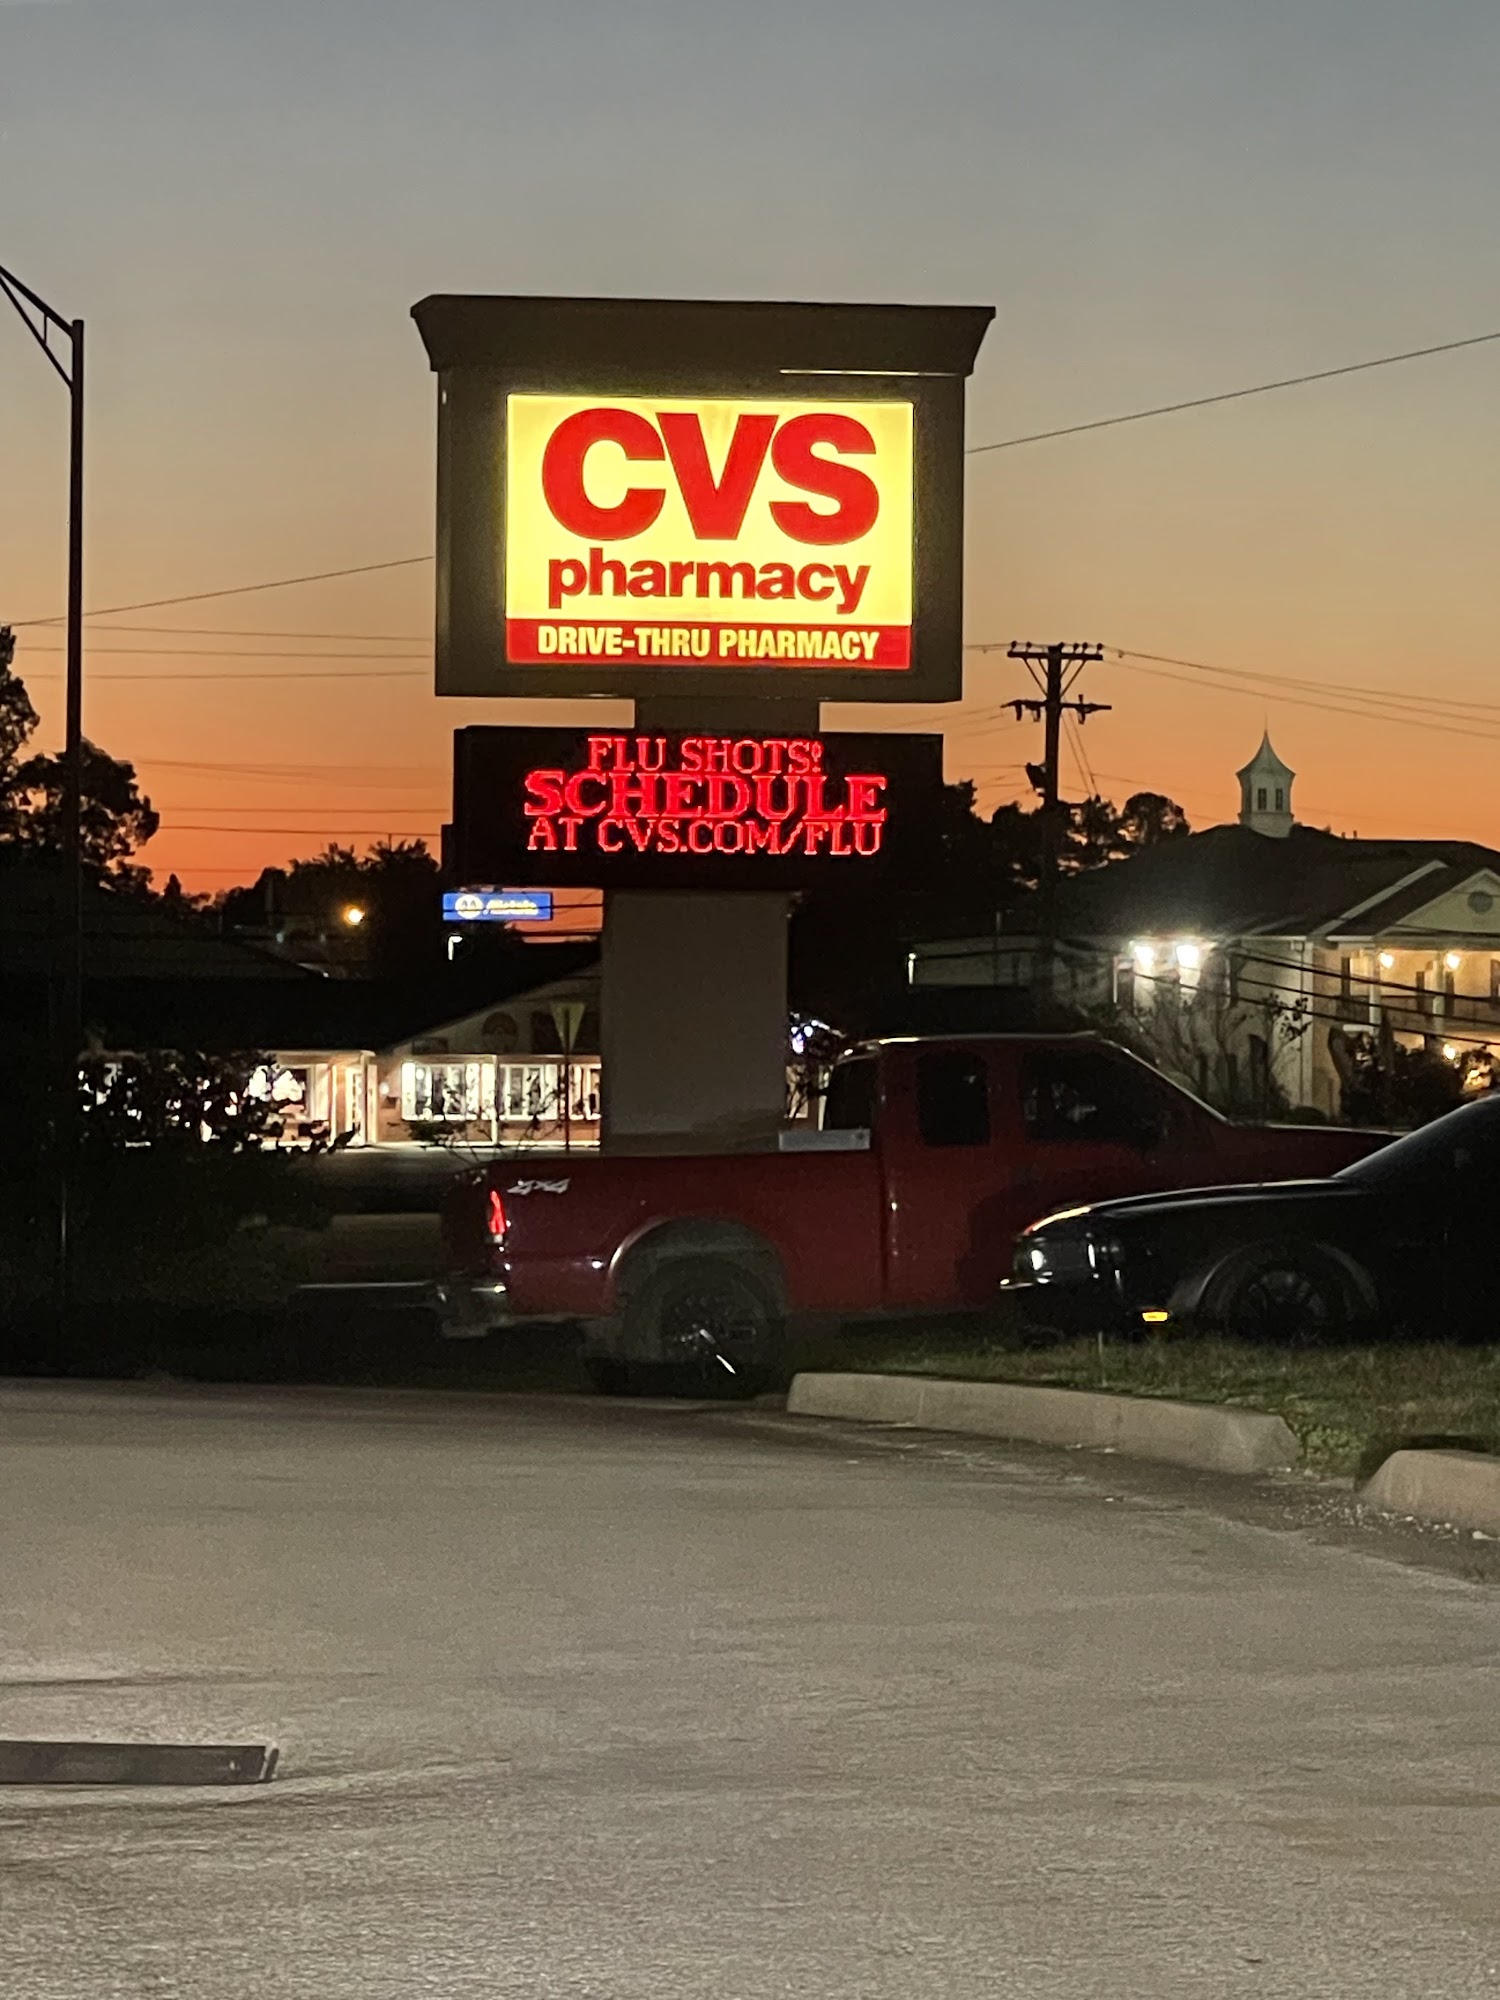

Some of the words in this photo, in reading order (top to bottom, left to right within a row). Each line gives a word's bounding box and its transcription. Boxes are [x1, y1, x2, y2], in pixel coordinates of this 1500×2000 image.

[542, 408, 879, 545] CVS
[548, 548, 871, 614] pharmacy
[538, 626, 710, 656] DRIVE-THRU
[718, 630, 879, 660] PHARMACY
[587, 737, 666, 771] FLU
[681, 738, 823, 774] SHOTS!
[524, 770, 887, 822] SCHEDULE
[527, 817, 583, 851] AT
[598, 818, 883, 855] CVS.COM/FLU
